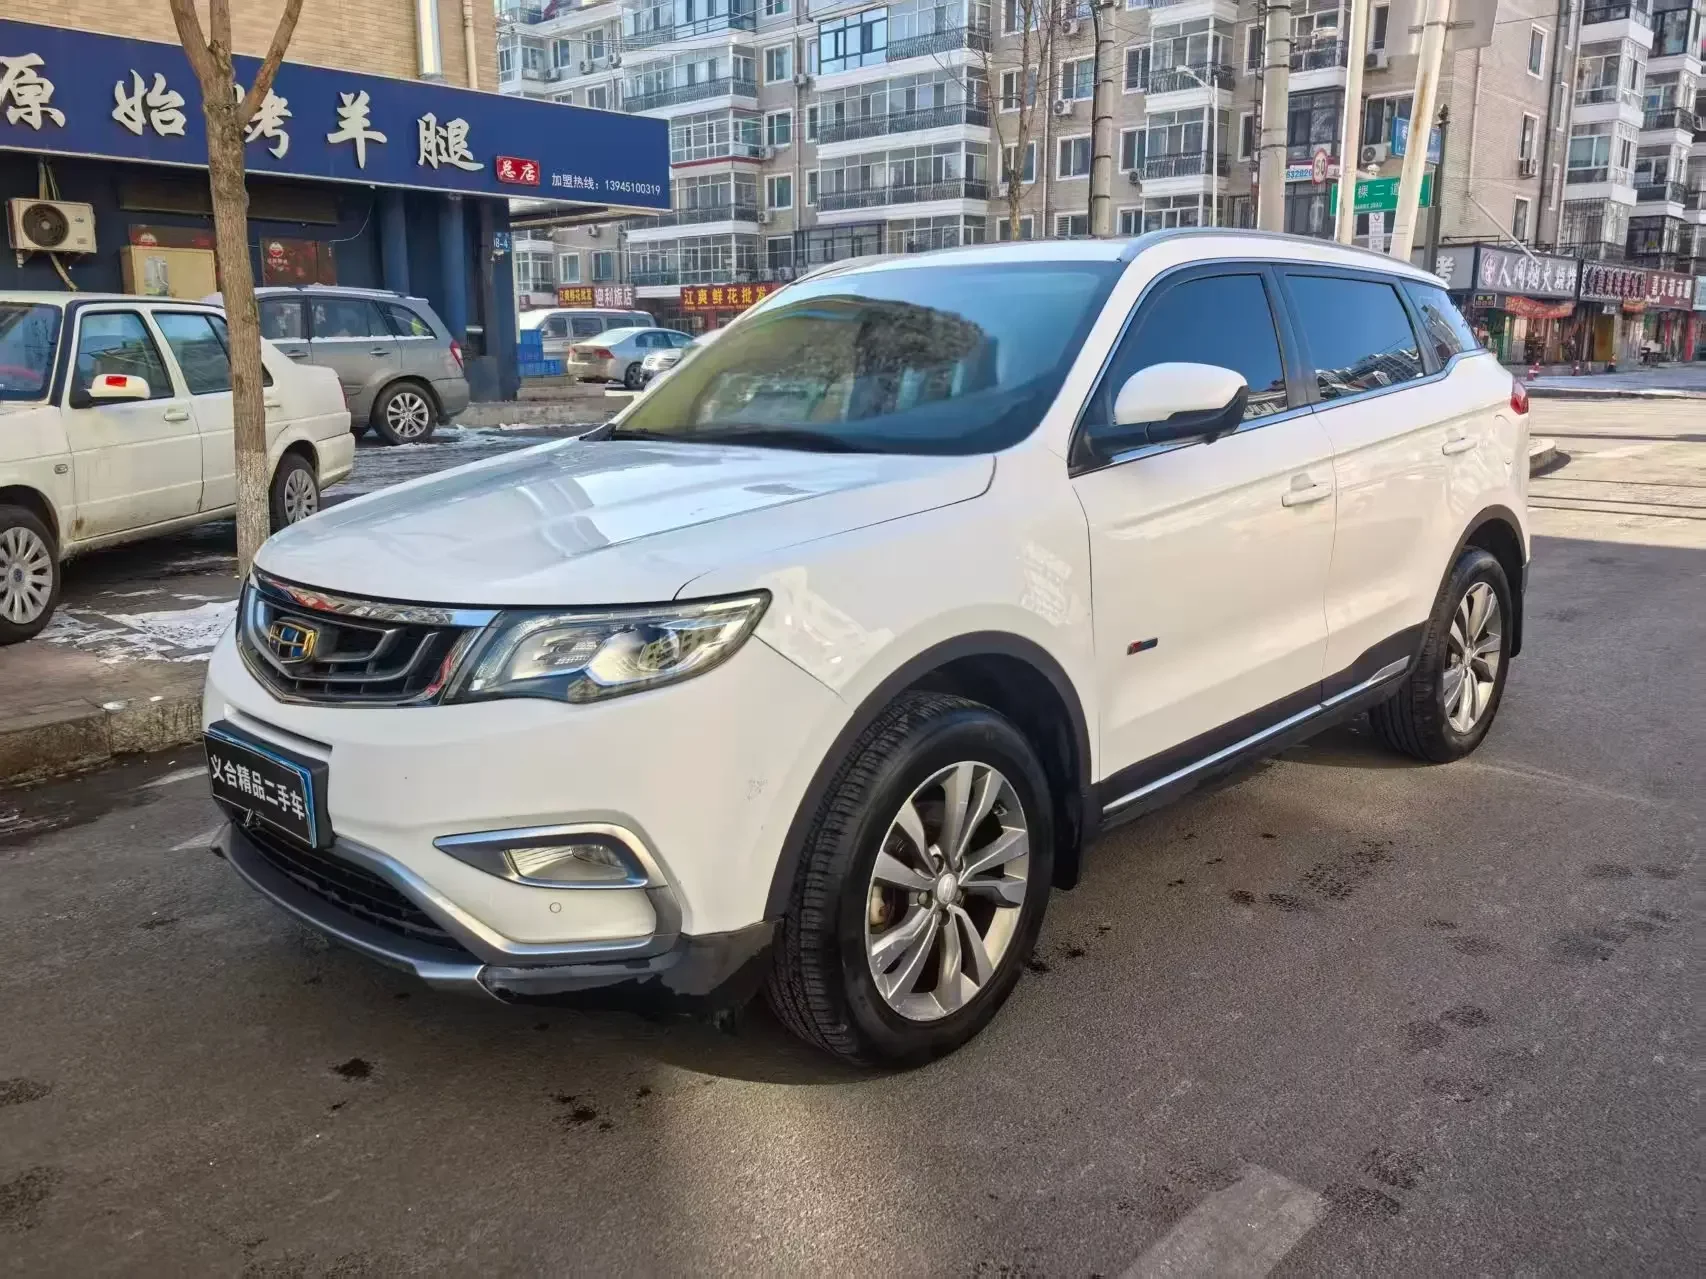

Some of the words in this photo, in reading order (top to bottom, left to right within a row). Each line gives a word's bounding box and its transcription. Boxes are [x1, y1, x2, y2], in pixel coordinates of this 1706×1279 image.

[500, 160, 537, 182] 总店
[684, 285, 767, 305] 江爽鲜花批发
[210, 753, 306, 821] 义合精品二手车
